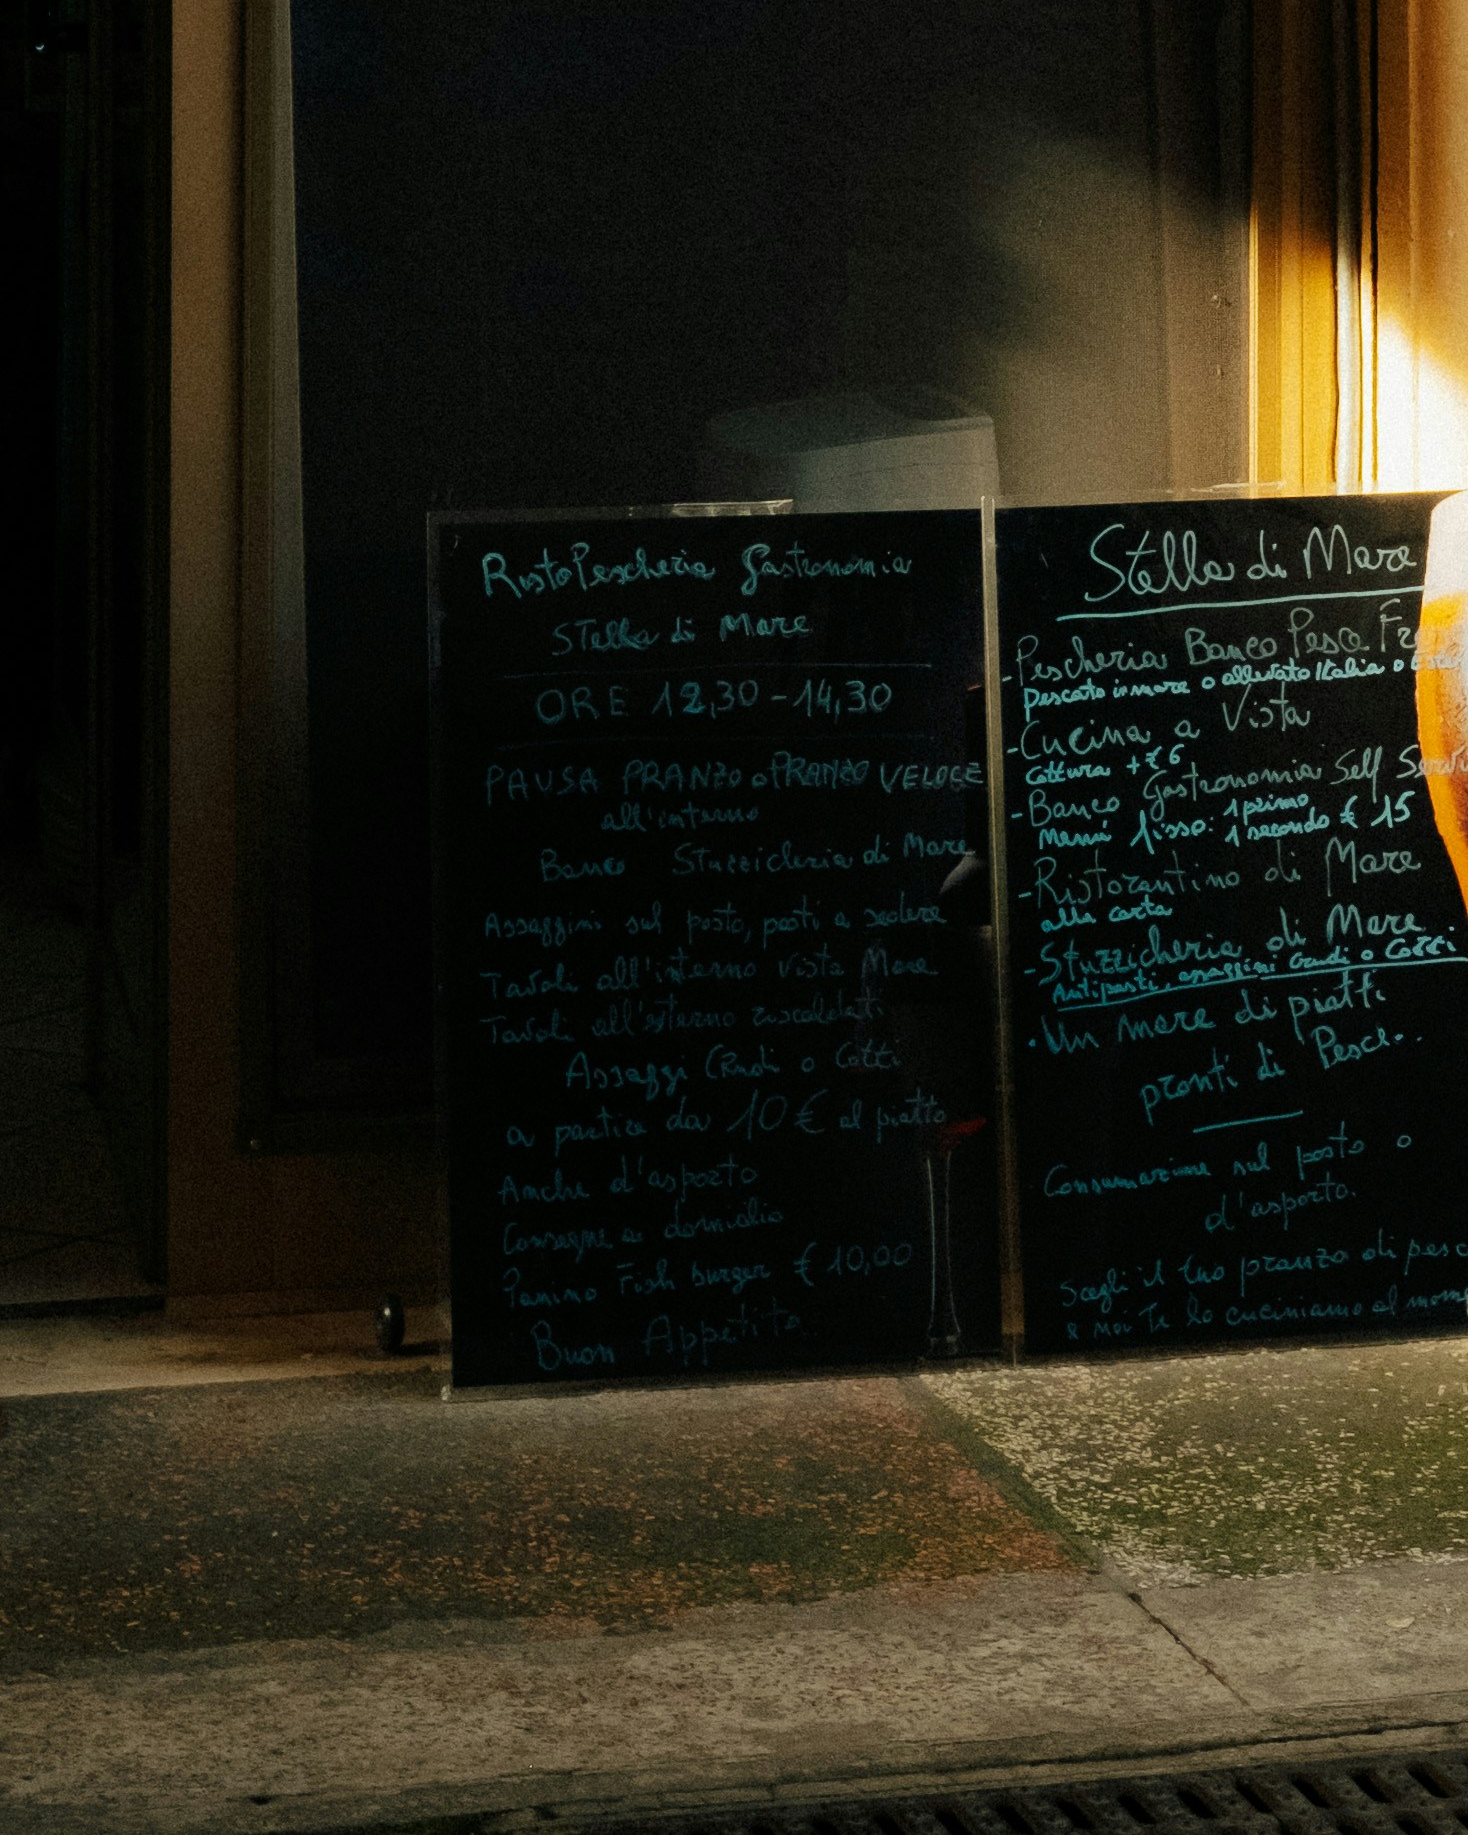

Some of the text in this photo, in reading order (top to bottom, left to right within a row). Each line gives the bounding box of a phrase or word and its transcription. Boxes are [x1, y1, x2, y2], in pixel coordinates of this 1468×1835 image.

[1085, 524, 1417, 601] Stella di Mare
[1185, 628, 1277, 665] Banco
[535, 686, 630, 725] ORE
[1175, 720, 1200, 739] a
[484, 764, 600, 807] PAUSA
[622, 759, 743, 795] PRANZO
[771, 750, 870, 790] PRANZO
[880, 762, 985, 794] VELOCE
[1325, 836, 1422, 897] Mare
